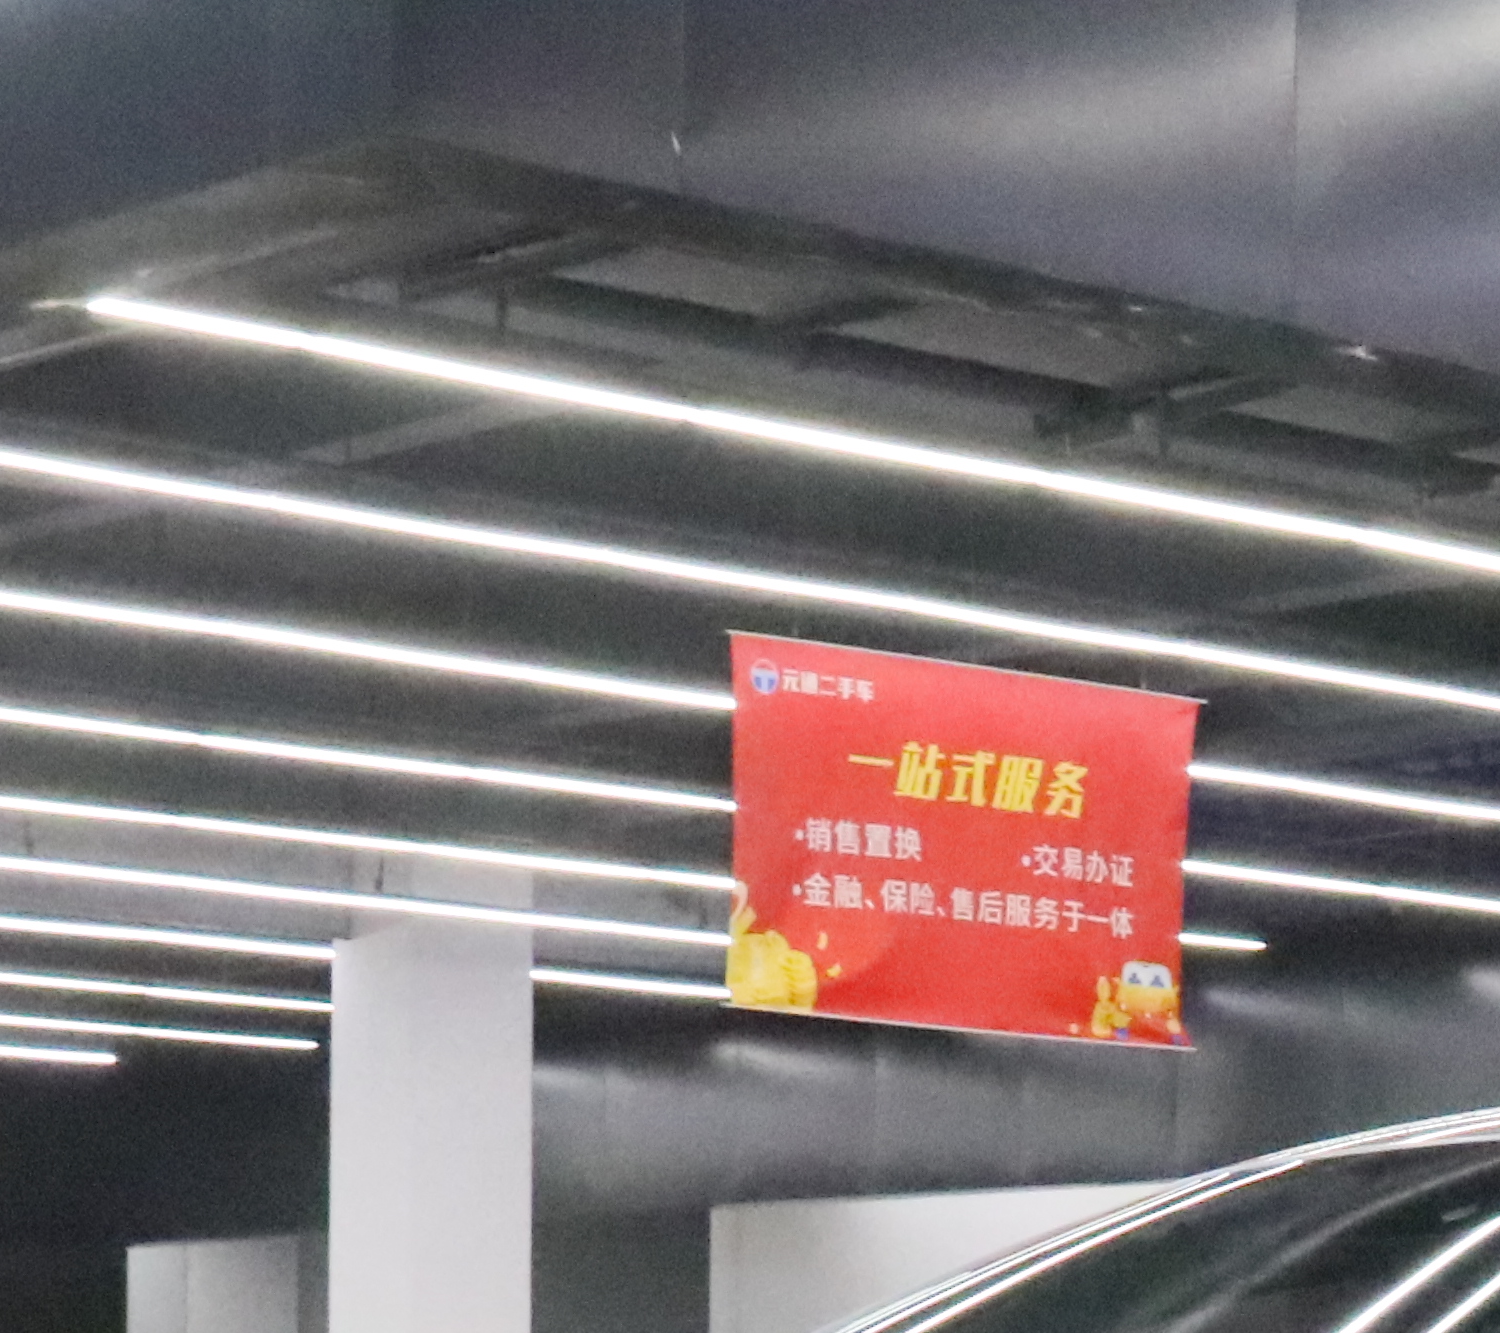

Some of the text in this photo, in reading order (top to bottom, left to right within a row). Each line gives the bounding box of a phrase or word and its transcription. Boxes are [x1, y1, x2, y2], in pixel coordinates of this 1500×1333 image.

[782, 668, 874, 702] 元二手车
[848, 740, 1089, 819] 一站式服务
[805, 818, 922, 861] 销售置换
[1032, 844, 1134, 887] 交易办证
[802, 873, 1134, 939] 金融、保险、售后服务于一体
